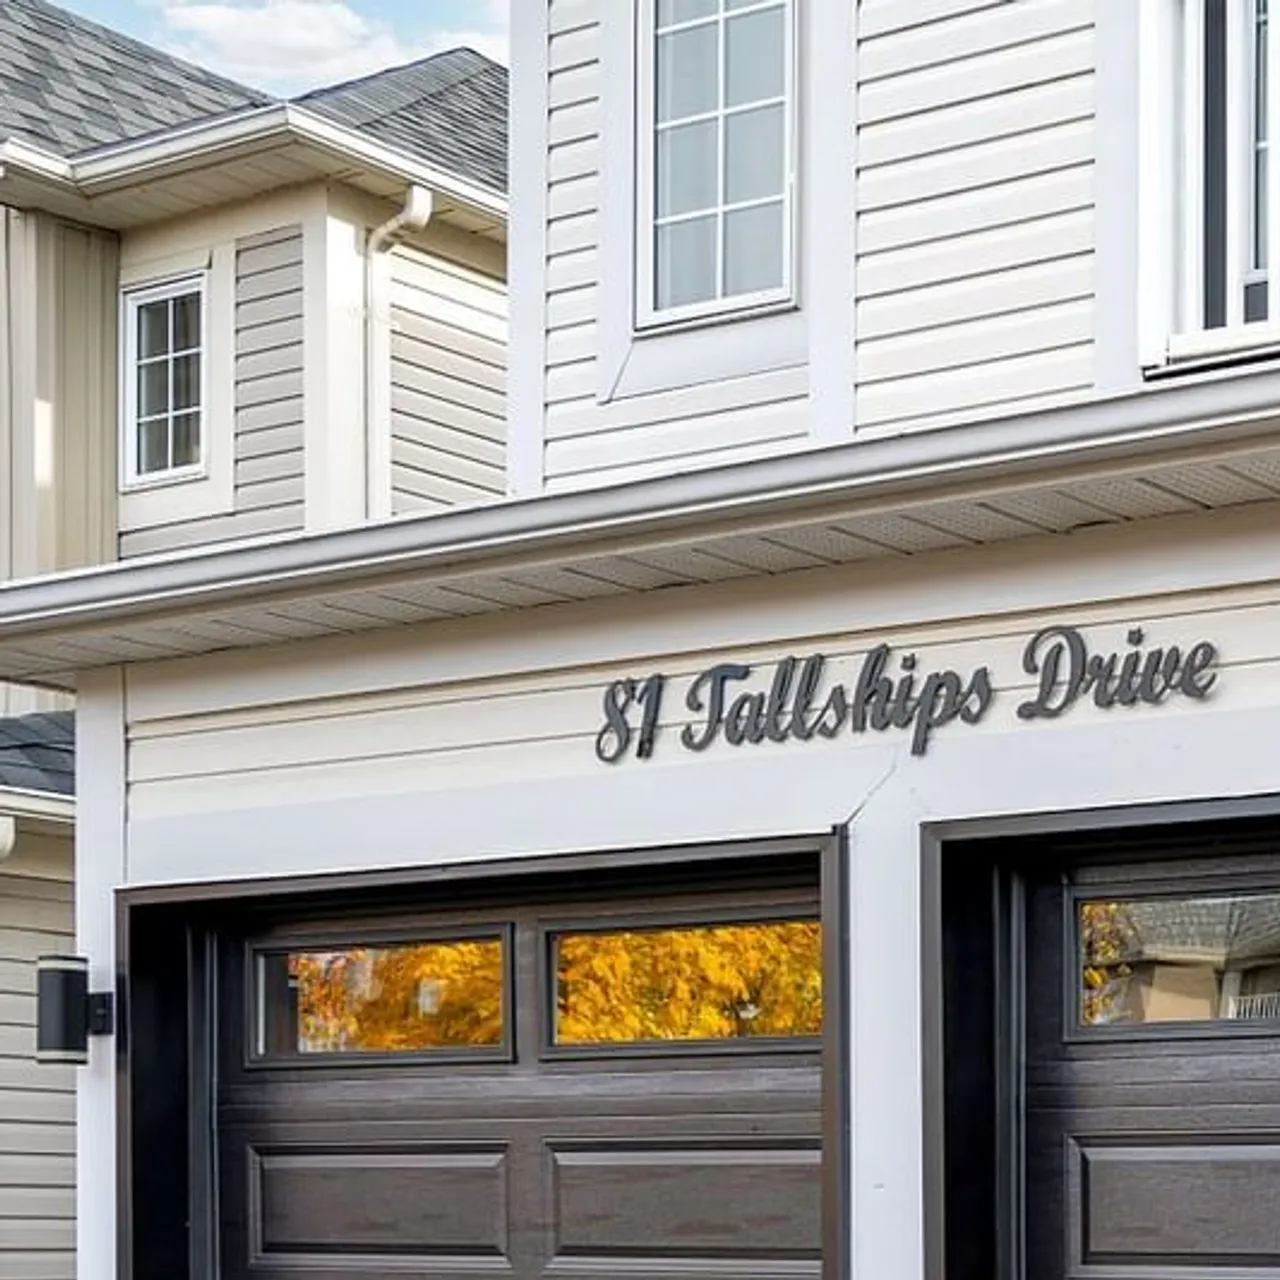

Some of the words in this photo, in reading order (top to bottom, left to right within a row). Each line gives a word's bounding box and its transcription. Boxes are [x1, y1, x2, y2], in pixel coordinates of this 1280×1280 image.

[595, 673, 664, 763] 81
[681, 643, 993, 756] Tallships
[1017, 625, 1218, 720] Drive
